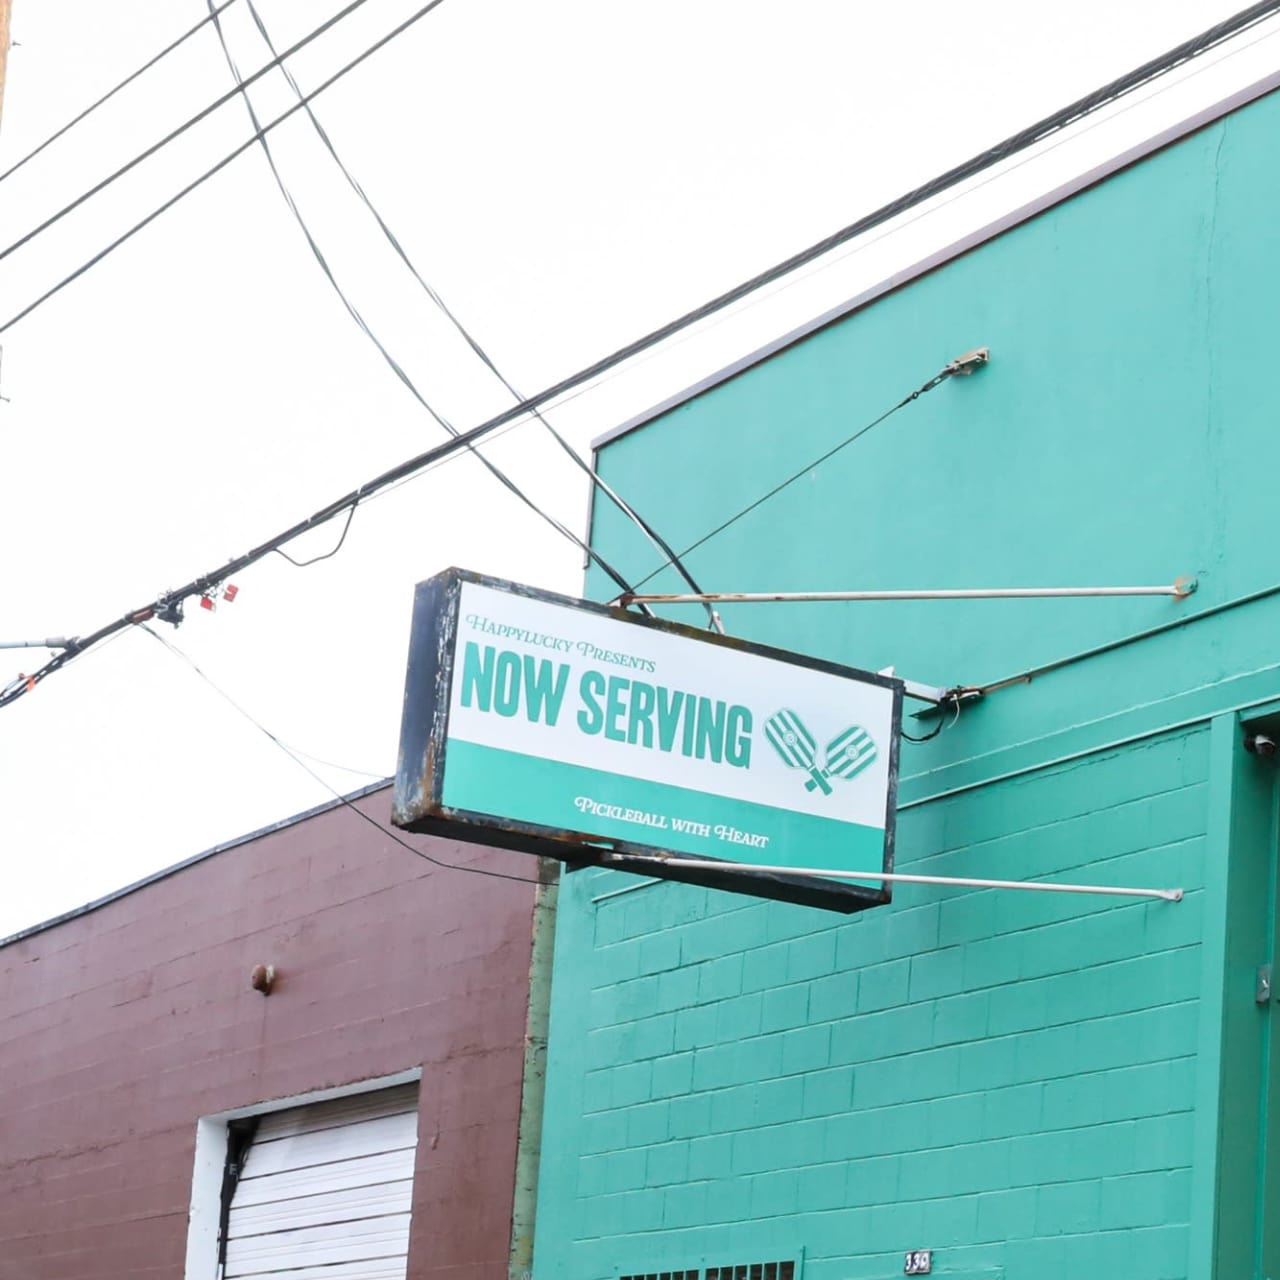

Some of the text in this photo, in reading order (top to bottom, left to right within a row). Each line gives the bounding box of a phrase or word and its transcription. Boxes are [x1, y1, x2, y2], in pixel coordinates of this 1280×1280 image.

[576, 641, 656, 673] PRESENTS
[460, 641, 753, 769] NOW SERVING
[574, 796, 769, 848] PICKLEBALL WITH HEART
